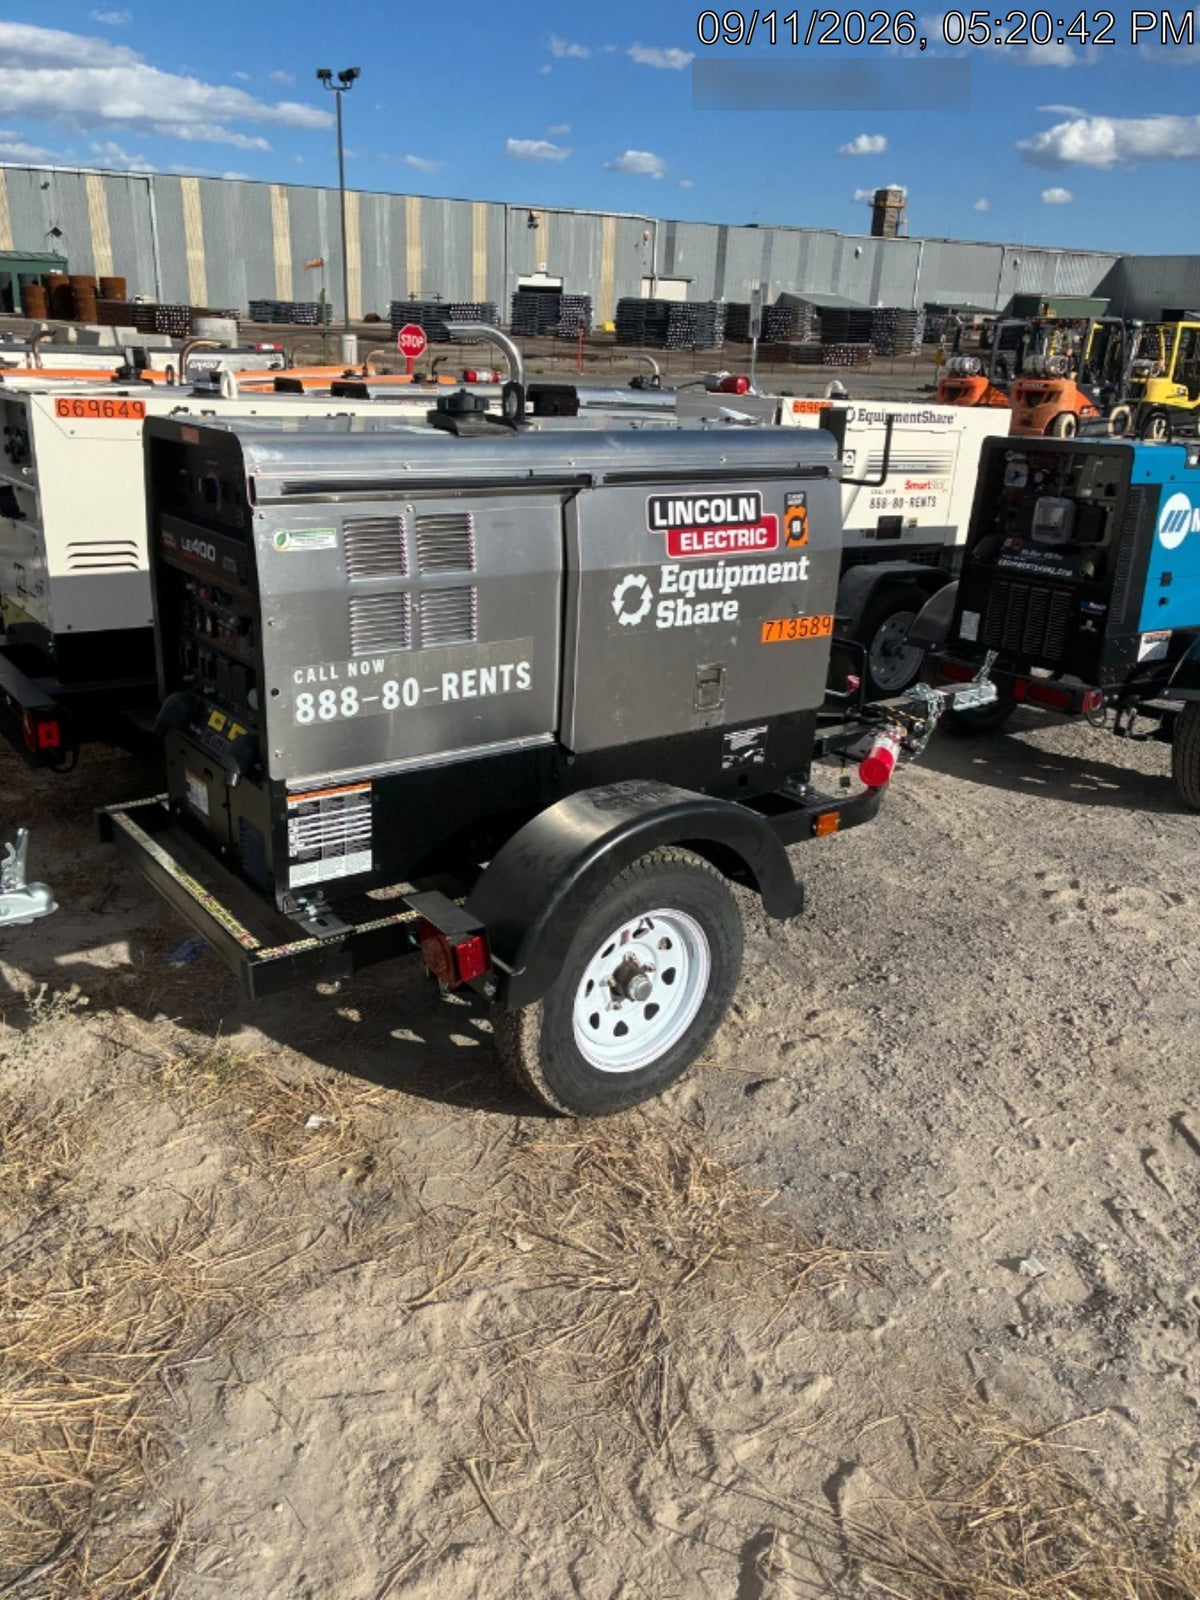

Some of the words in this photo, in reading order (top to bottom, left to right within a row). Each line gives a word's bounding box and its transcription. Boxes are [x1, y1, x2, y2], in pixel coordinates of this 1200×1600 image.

[401, 334, 424, 348] STOP
[56, 399, 144, 417] 669649
[654, 497, 756, 526] LINCOLN
[680, 528, 768, 551] ELECTRIC
[659, 556, 810, 598] Equipment
[656, 598, 739, 629] Share
[765, 616, 831, 641] 713589
[294, 665, 339, 684] CALL
[348, 659, 385, 677] NOW
[295, 661, 532, 723] 888-80-RENTS
